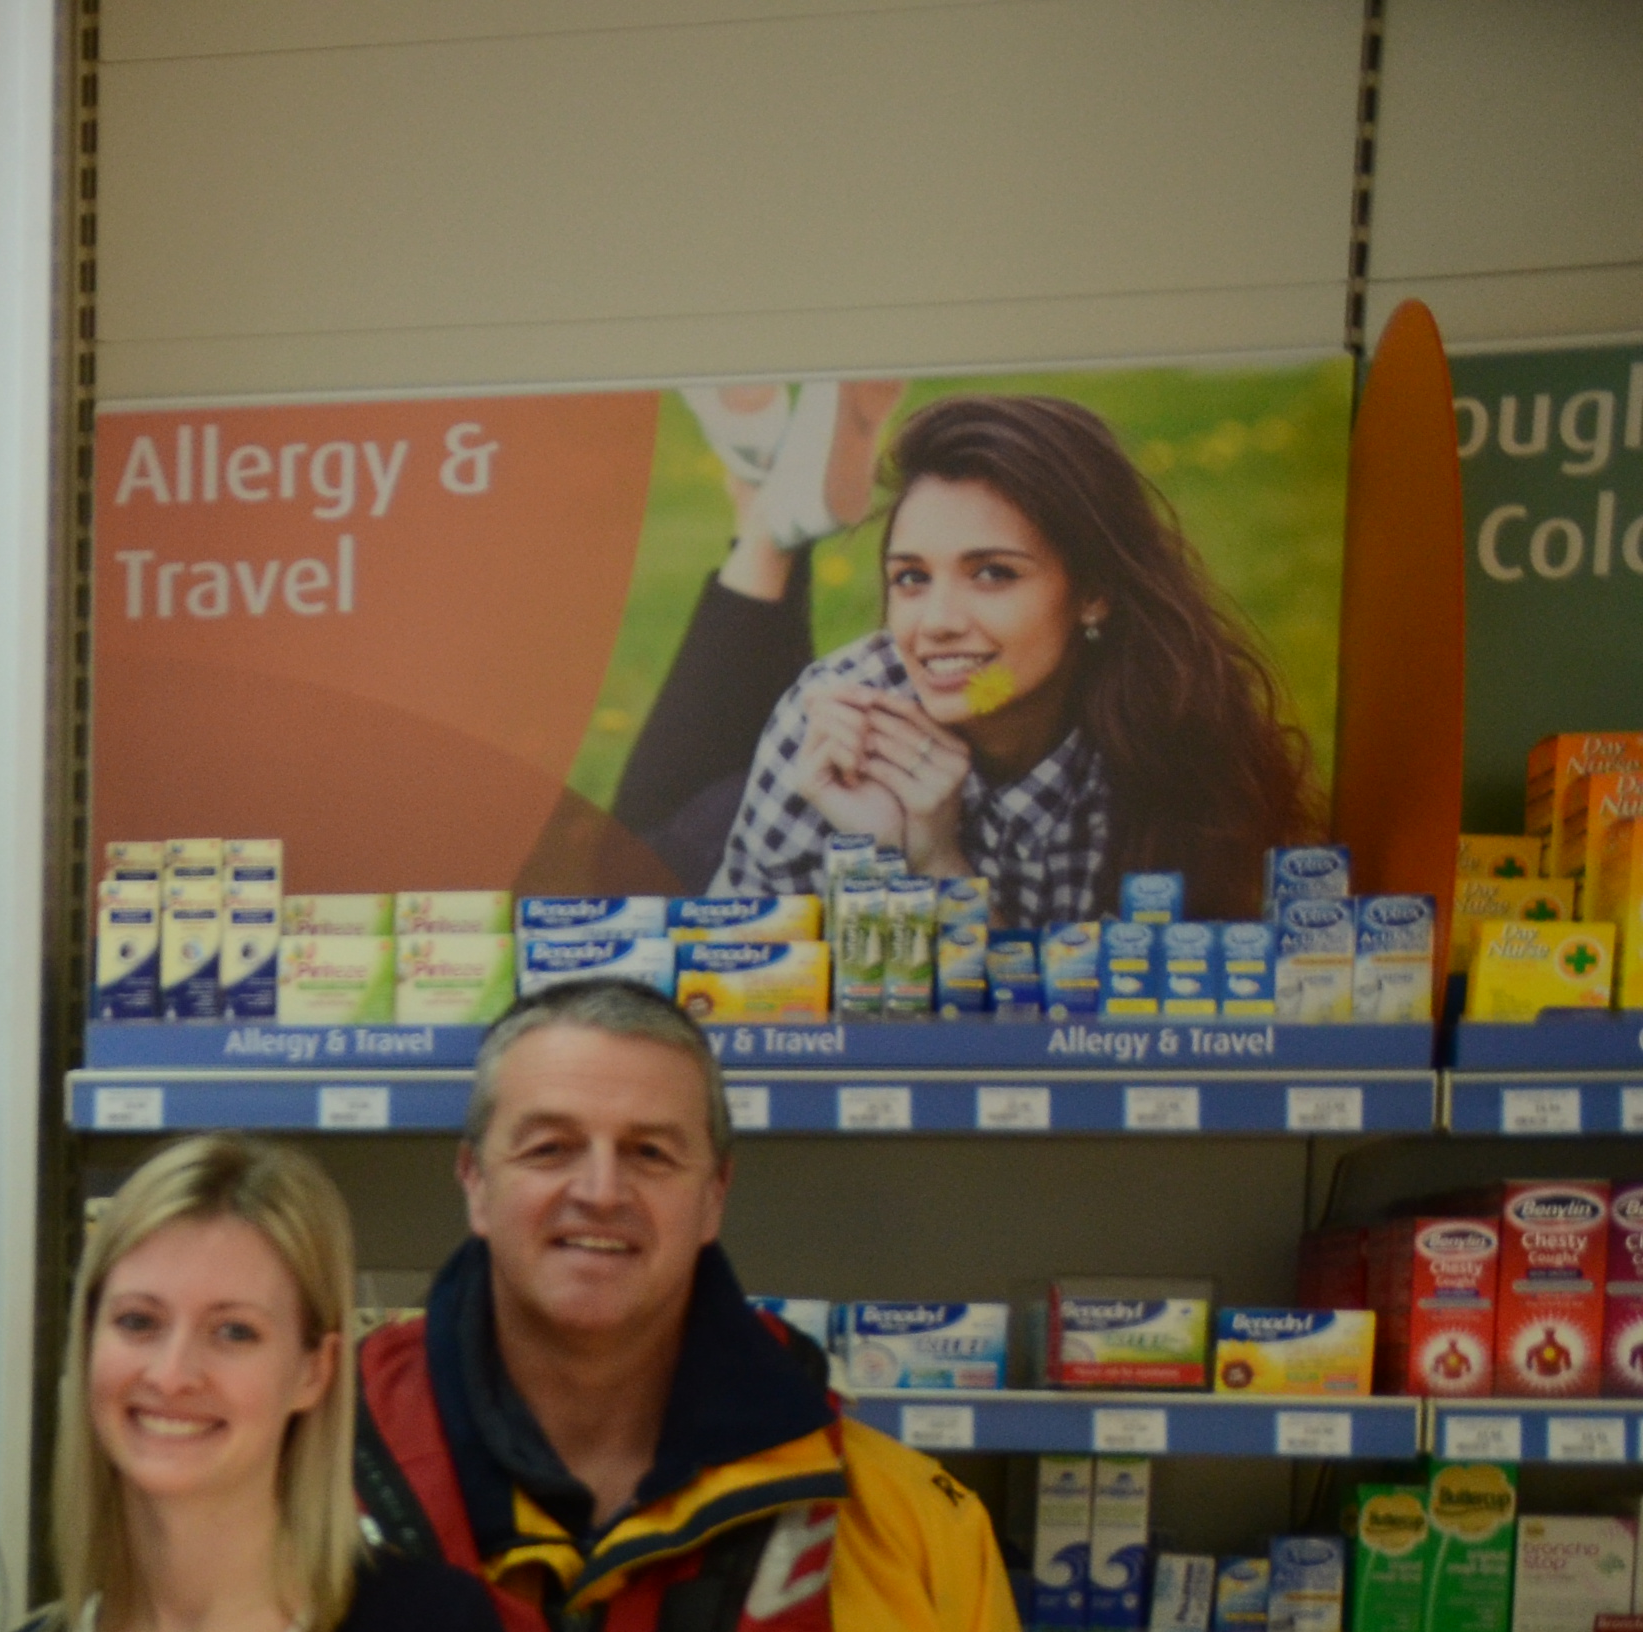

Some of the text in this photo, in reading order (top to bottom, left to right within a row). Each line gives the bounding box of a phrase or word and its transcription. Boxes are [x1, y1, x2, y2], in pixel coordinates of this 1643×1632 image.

[1455, 362, 1643, 476] oug
[115, 421, 499, 520] Allergy &
[116, 534, 355, 619] Travel
[682, 900, 758, 922] Benadryl
[1502, 925, 1539, 943] Day
[530, 943, 612, 961] Benadryl
[692, 944, 770, 963] Benadryl
[1488, 940, 1549, 960] Nurse
[224, 1028, 433, 1060] Allergy & Travel
[734, 1027, 845, 1053] & Travel
[1048, 1026, 1274, 1059] Allergy & Travel
[1520, 1201, 1592, 1217] Benylin
[1522, 1233, 1587, 1251] Chesty
[1430, 1260, 1483, 1277] Chesty
[1232, 1313, 1313, 1333] Benadryl
